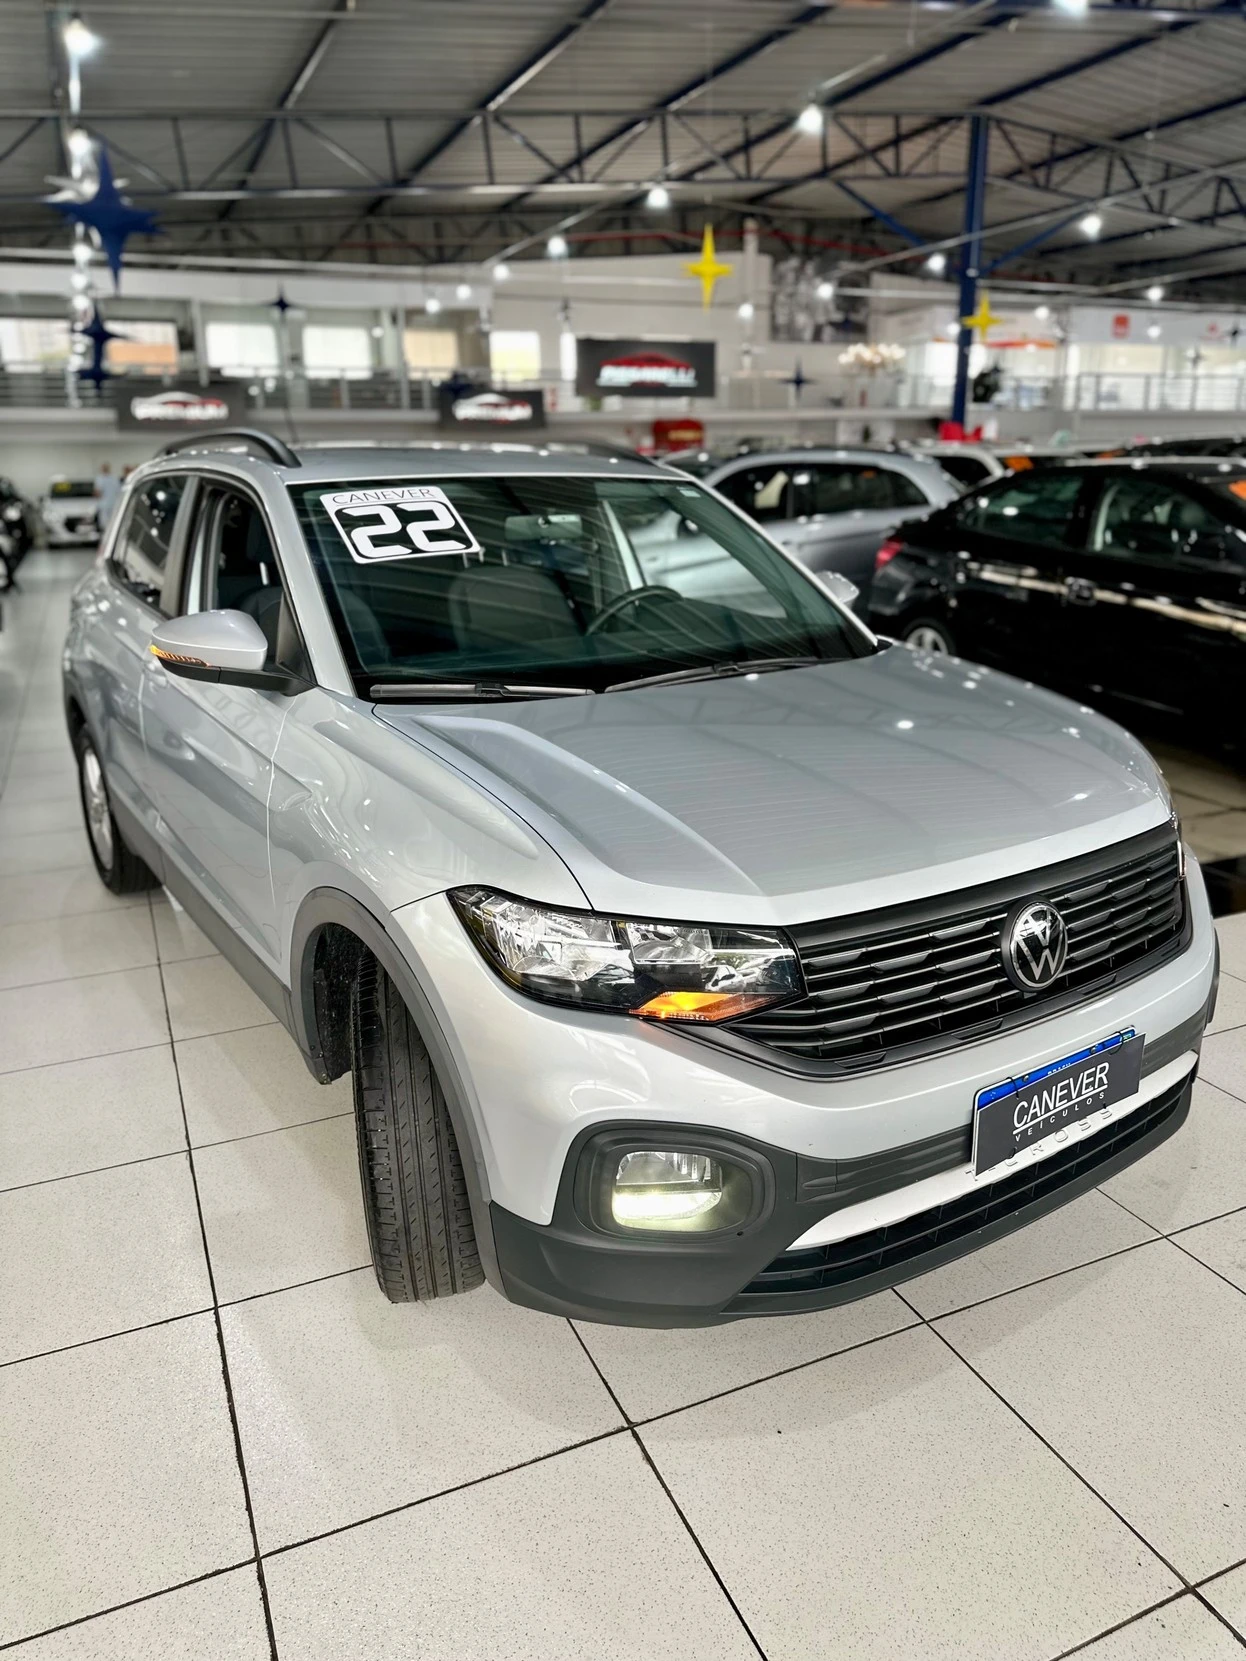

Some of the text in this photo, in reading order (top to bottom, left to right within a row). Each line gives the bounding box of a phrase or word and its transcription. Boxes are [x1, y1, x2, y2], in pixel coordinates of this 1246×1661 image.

[332, 488, 434, 504] CANEVER
[343, 502, 467, 558] 22
[1013, 1062, 1110, 1128] CANEVER
